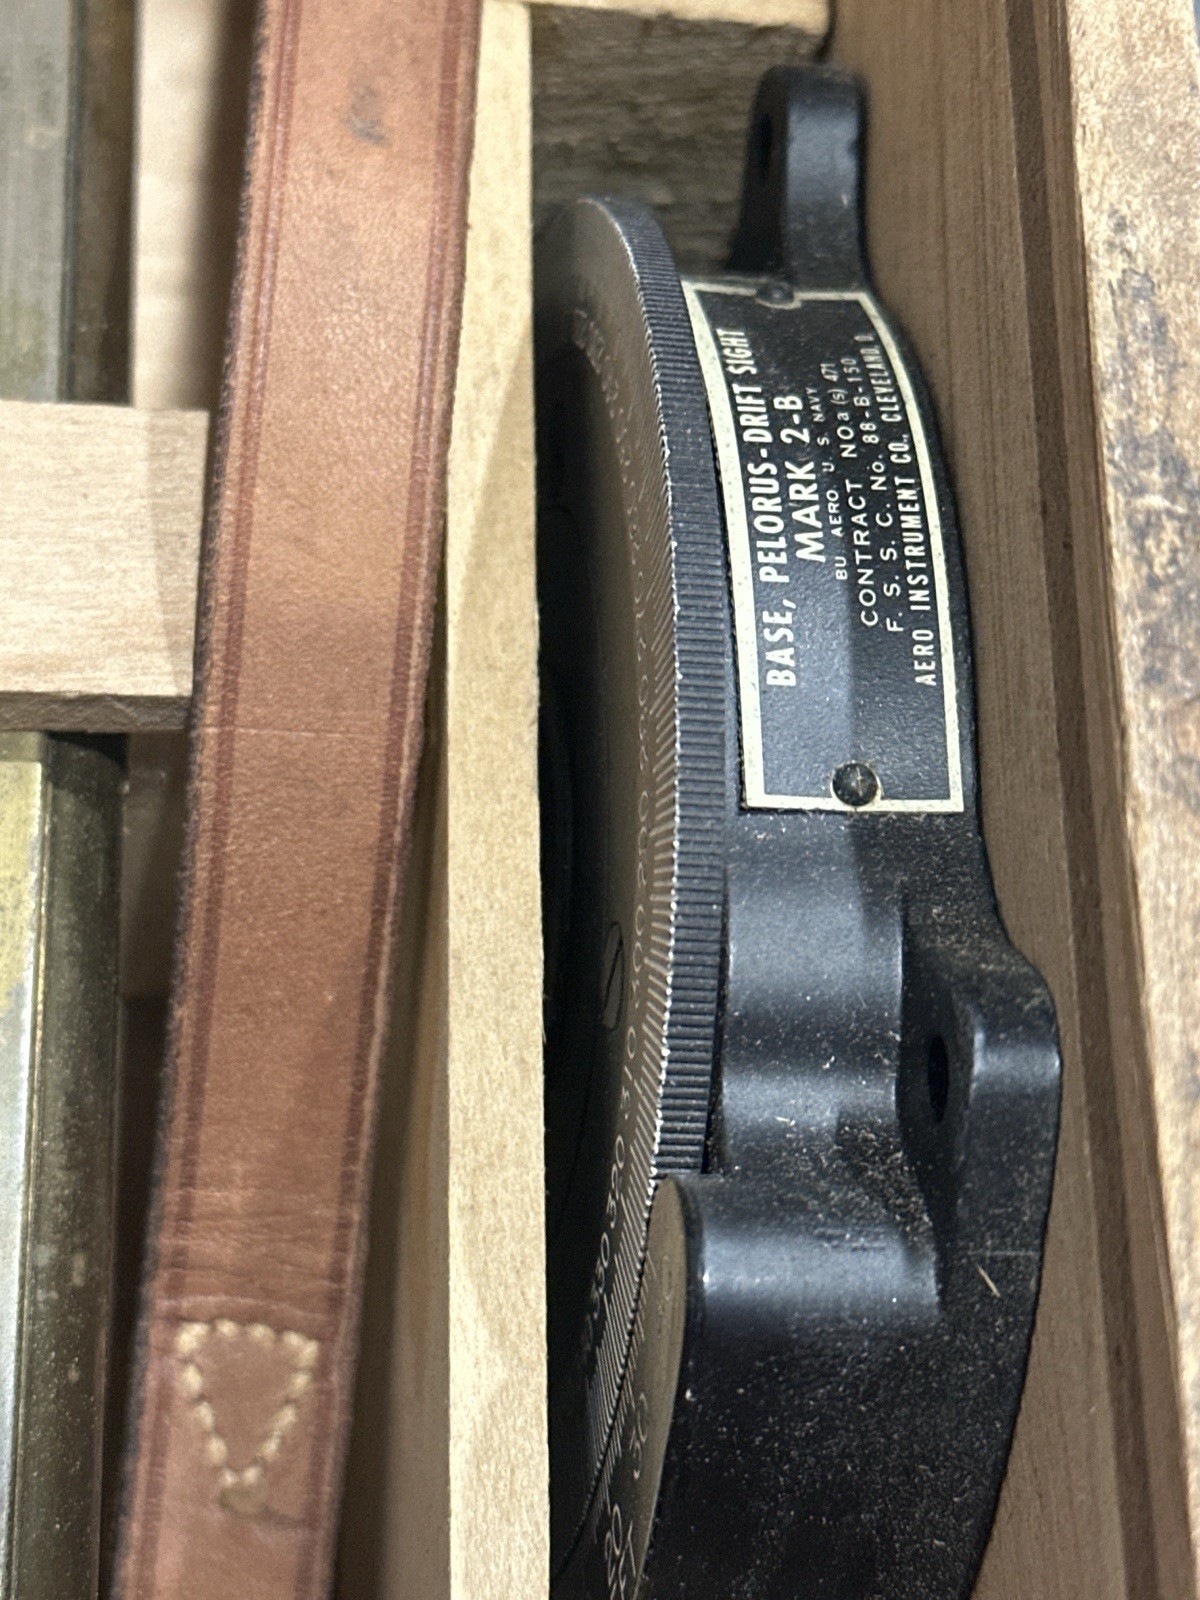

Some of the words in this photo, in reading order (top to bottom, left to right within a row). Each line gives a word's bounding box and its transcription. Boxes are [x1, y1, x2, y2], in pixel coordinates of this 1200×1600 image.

[715, 328, 757, 375] SIGHT
[772, 395, 810, 444] 2-B
[805, 387, 826, 423] NAVY
[871, 454, 888, 491] No.
[784, 461, 826, 563] MARK
[875, 503, 894, 528] C.
[845, 478, 879, 627] CONTRACT
[879, 540, 897, 561] S.
[894, 475, 932, 611] INSTRUMENT
[882, 575, 901, 597] S.
[762, 598, 797, 687] BASE,
[885, 612, 904, 632] F.
[912, 628, 937, 686] AERO
[605, 1134, 625, 1230] 320
[604, 1503, 623, 1587] 20
